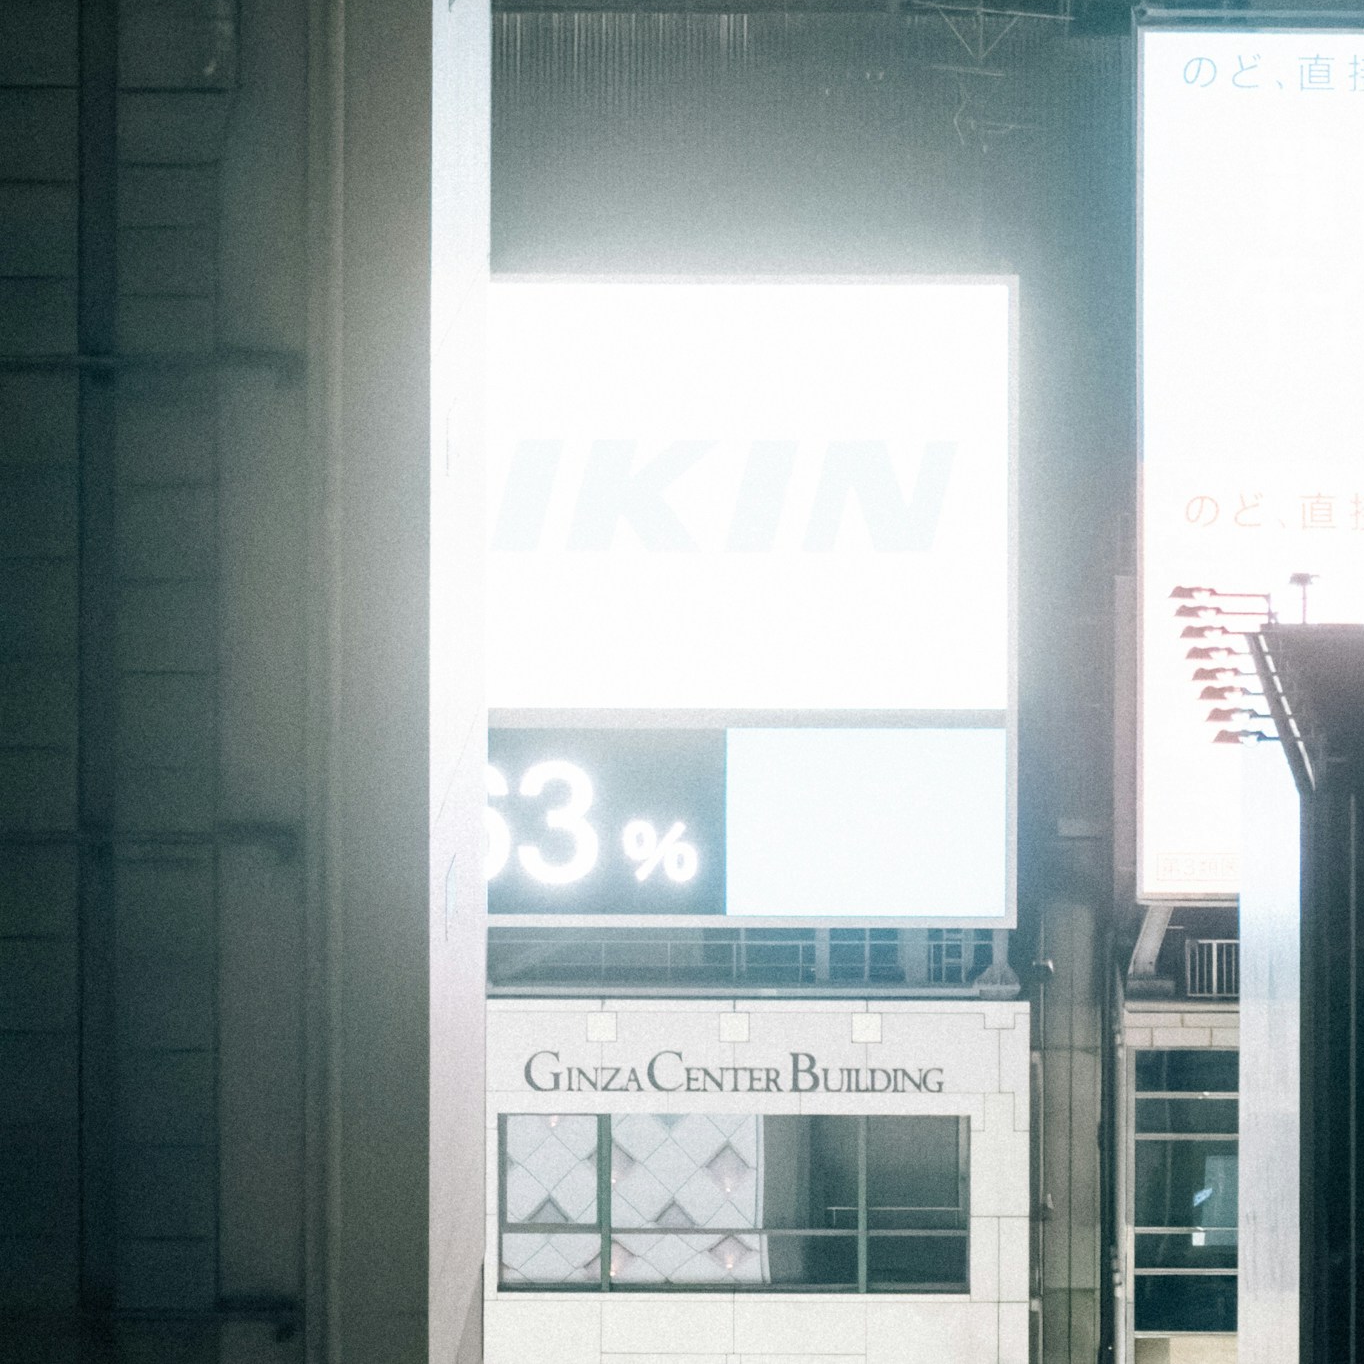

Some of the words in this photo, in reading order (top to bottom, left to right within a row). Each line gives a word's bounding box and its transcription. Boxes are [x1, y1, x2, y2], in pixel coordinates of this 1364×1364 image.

[523, 1049, 641, 1093] GINZA
[646, 1050, 782, 1093] CENTER
[789, 1052, 945, 1094] BUILDING
